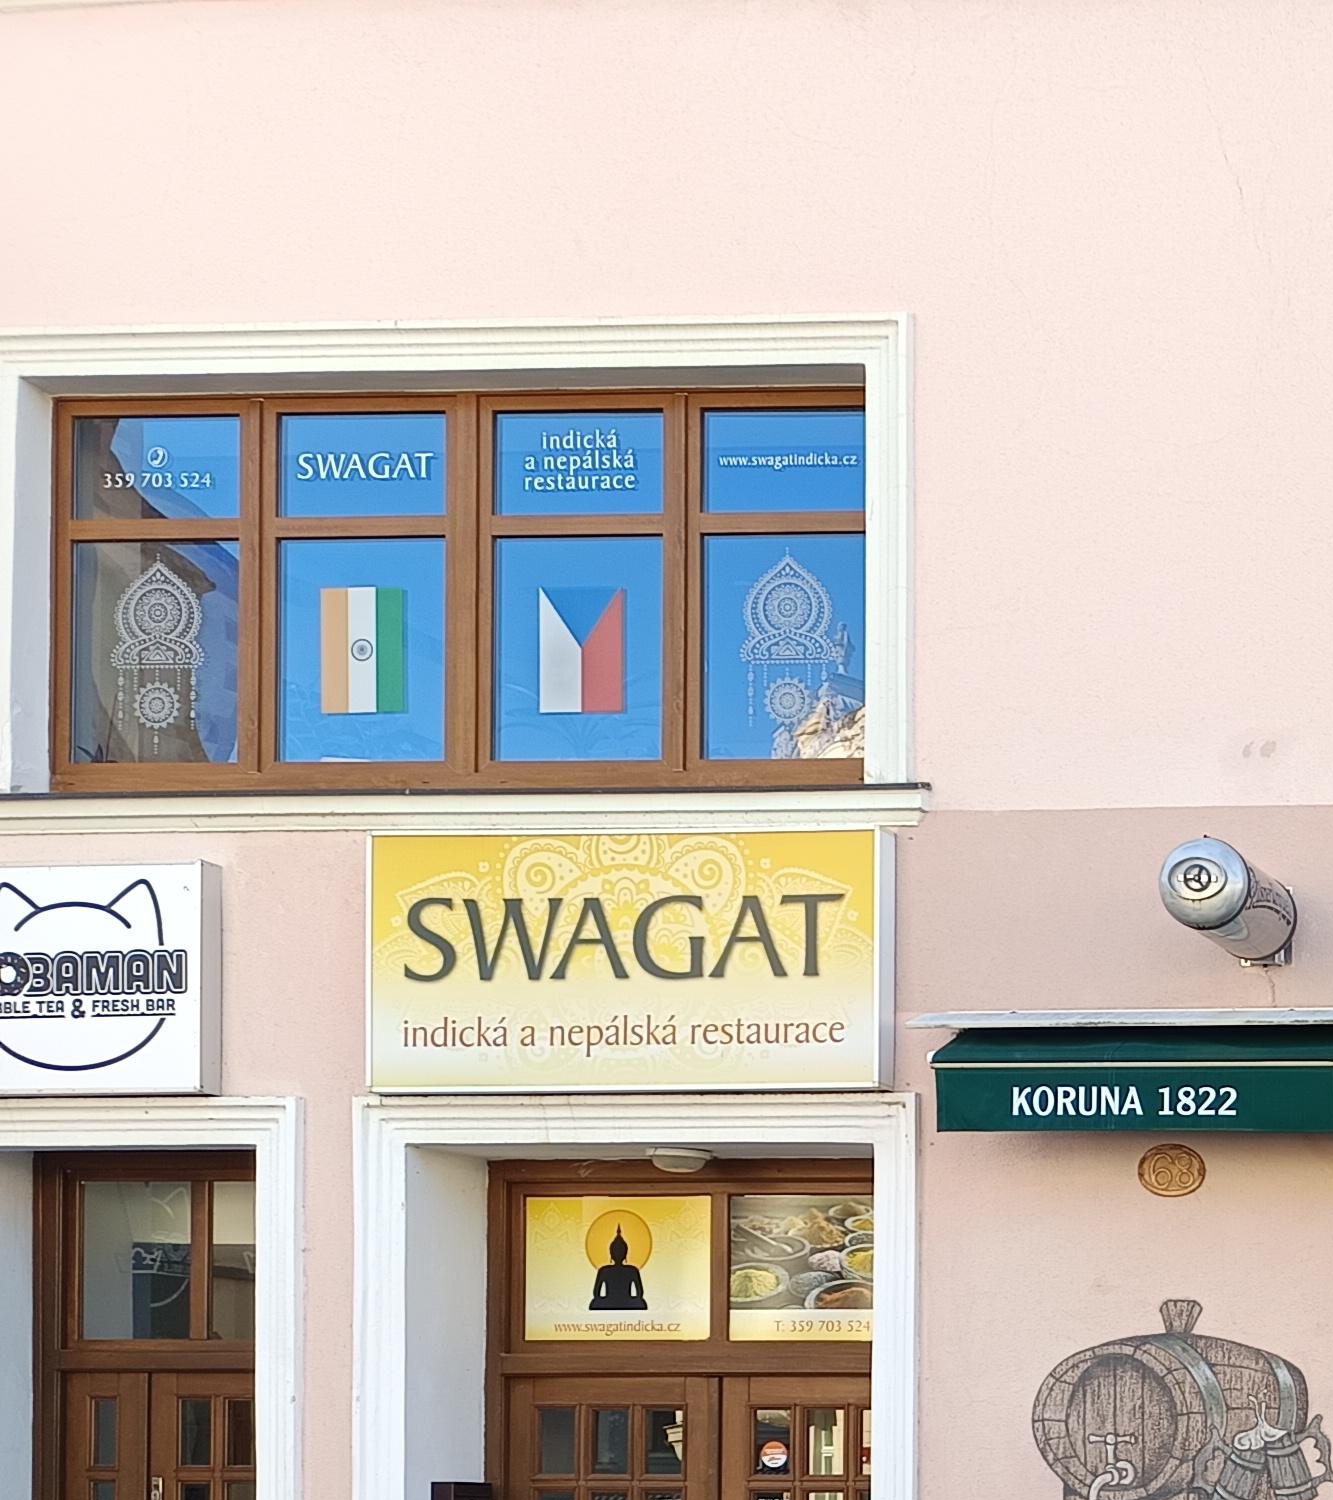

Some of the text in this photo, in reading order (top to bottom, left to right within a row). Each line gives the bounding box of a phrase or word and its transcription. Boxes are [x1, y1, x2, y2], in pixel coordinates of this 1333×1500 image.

[541, 429, 618, 450] indická
[297, 452, 433, 480] SWAGAT
[524, 450, 635, 475] a nepálská
[719, 452, 858, 471] www.swagatindicka.cz
[103, 472, 211, 488] 359 703 524
[524, 474, 636, 491] restaurace
[403, 894, 845, 982] SWAGAT
[36, 1000, 65, 1013] TEA
[71, 999, 86, 1018] &
[92, 999, 140, 1012] FRESH
[146, 999, 176, 1012] BAR
[403, 1015, 846, 1057] indická a nepálská restaurace
[1012, 1085, 1238, 1116] KORUNA 1822
[1150, 1152, 1195, 1188] 68
[554, 1319, 681, 1336] www.swagatindicka.cz
[776, 1319, 871, 1333] T: 359 703 524
